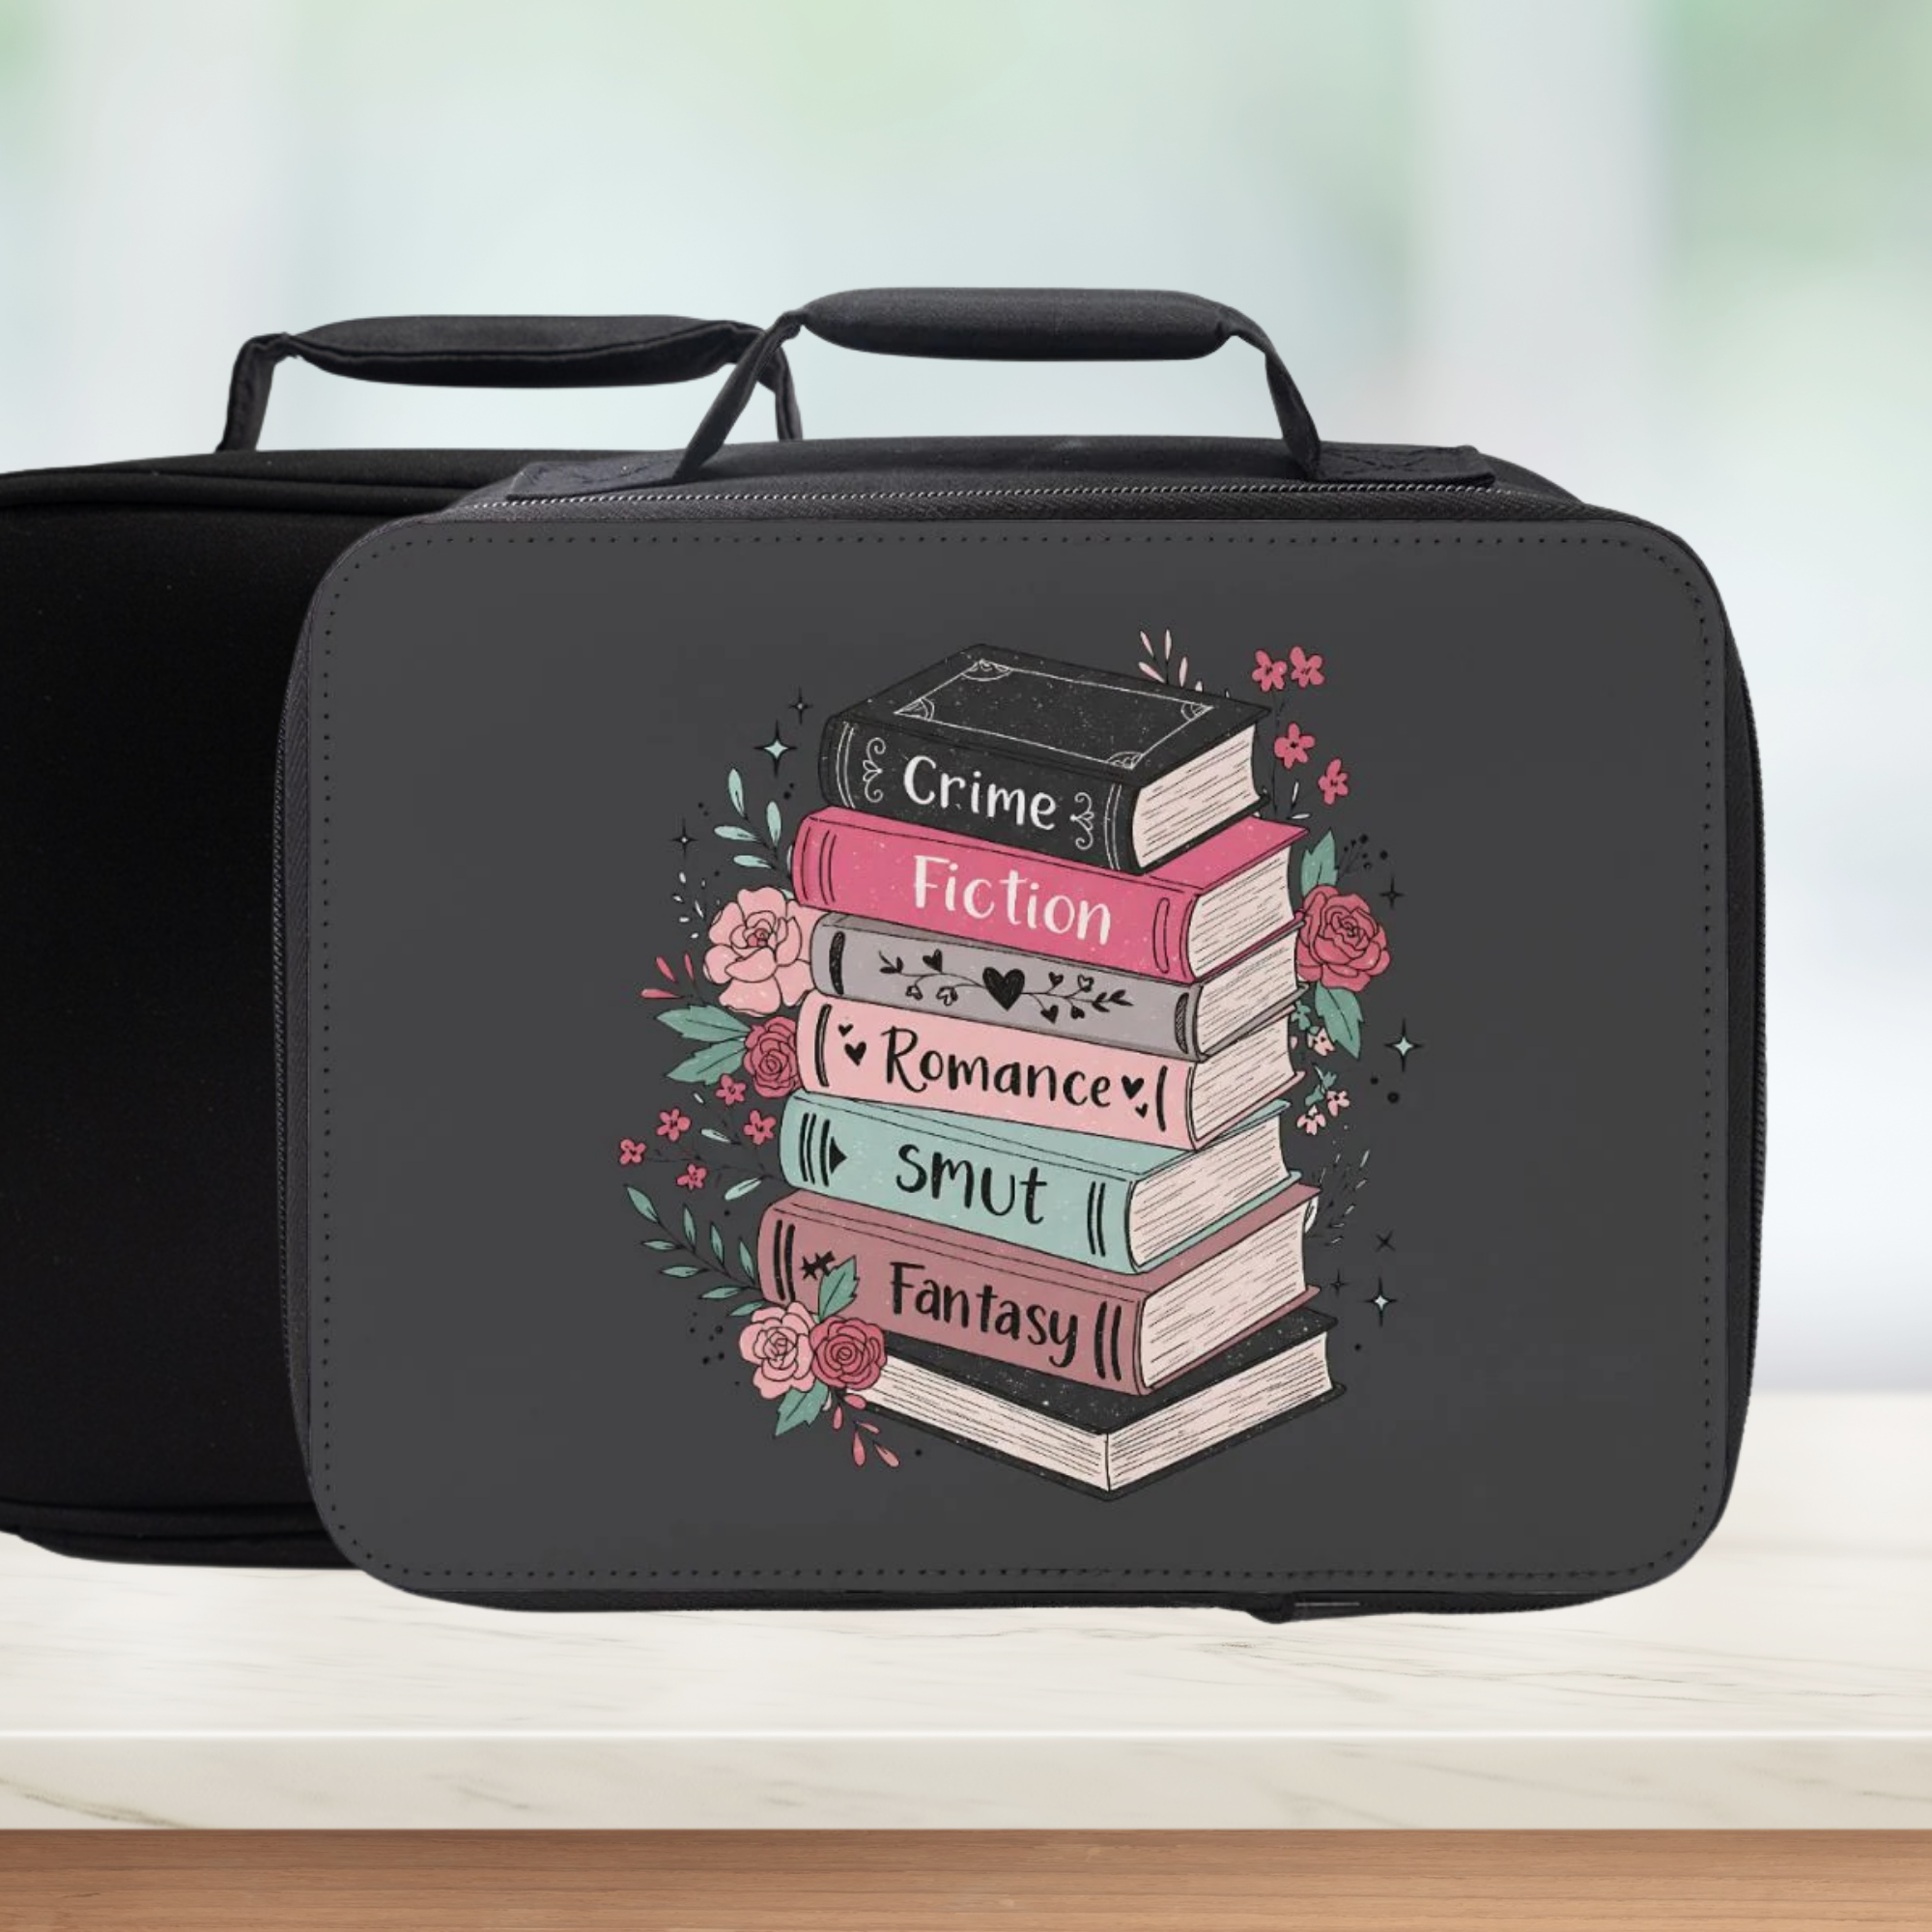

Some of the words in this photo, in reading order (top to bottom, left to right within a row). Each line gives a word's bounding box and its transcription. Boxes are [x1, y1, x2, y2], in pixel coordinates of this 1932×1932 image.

[903, 755, 1060, 831] Crime
[913, 854, 1112, 946] Fiction
[880, 1025, 1112, 1108] Romance
[890, 1262, 1079, 1369] Fantasy
